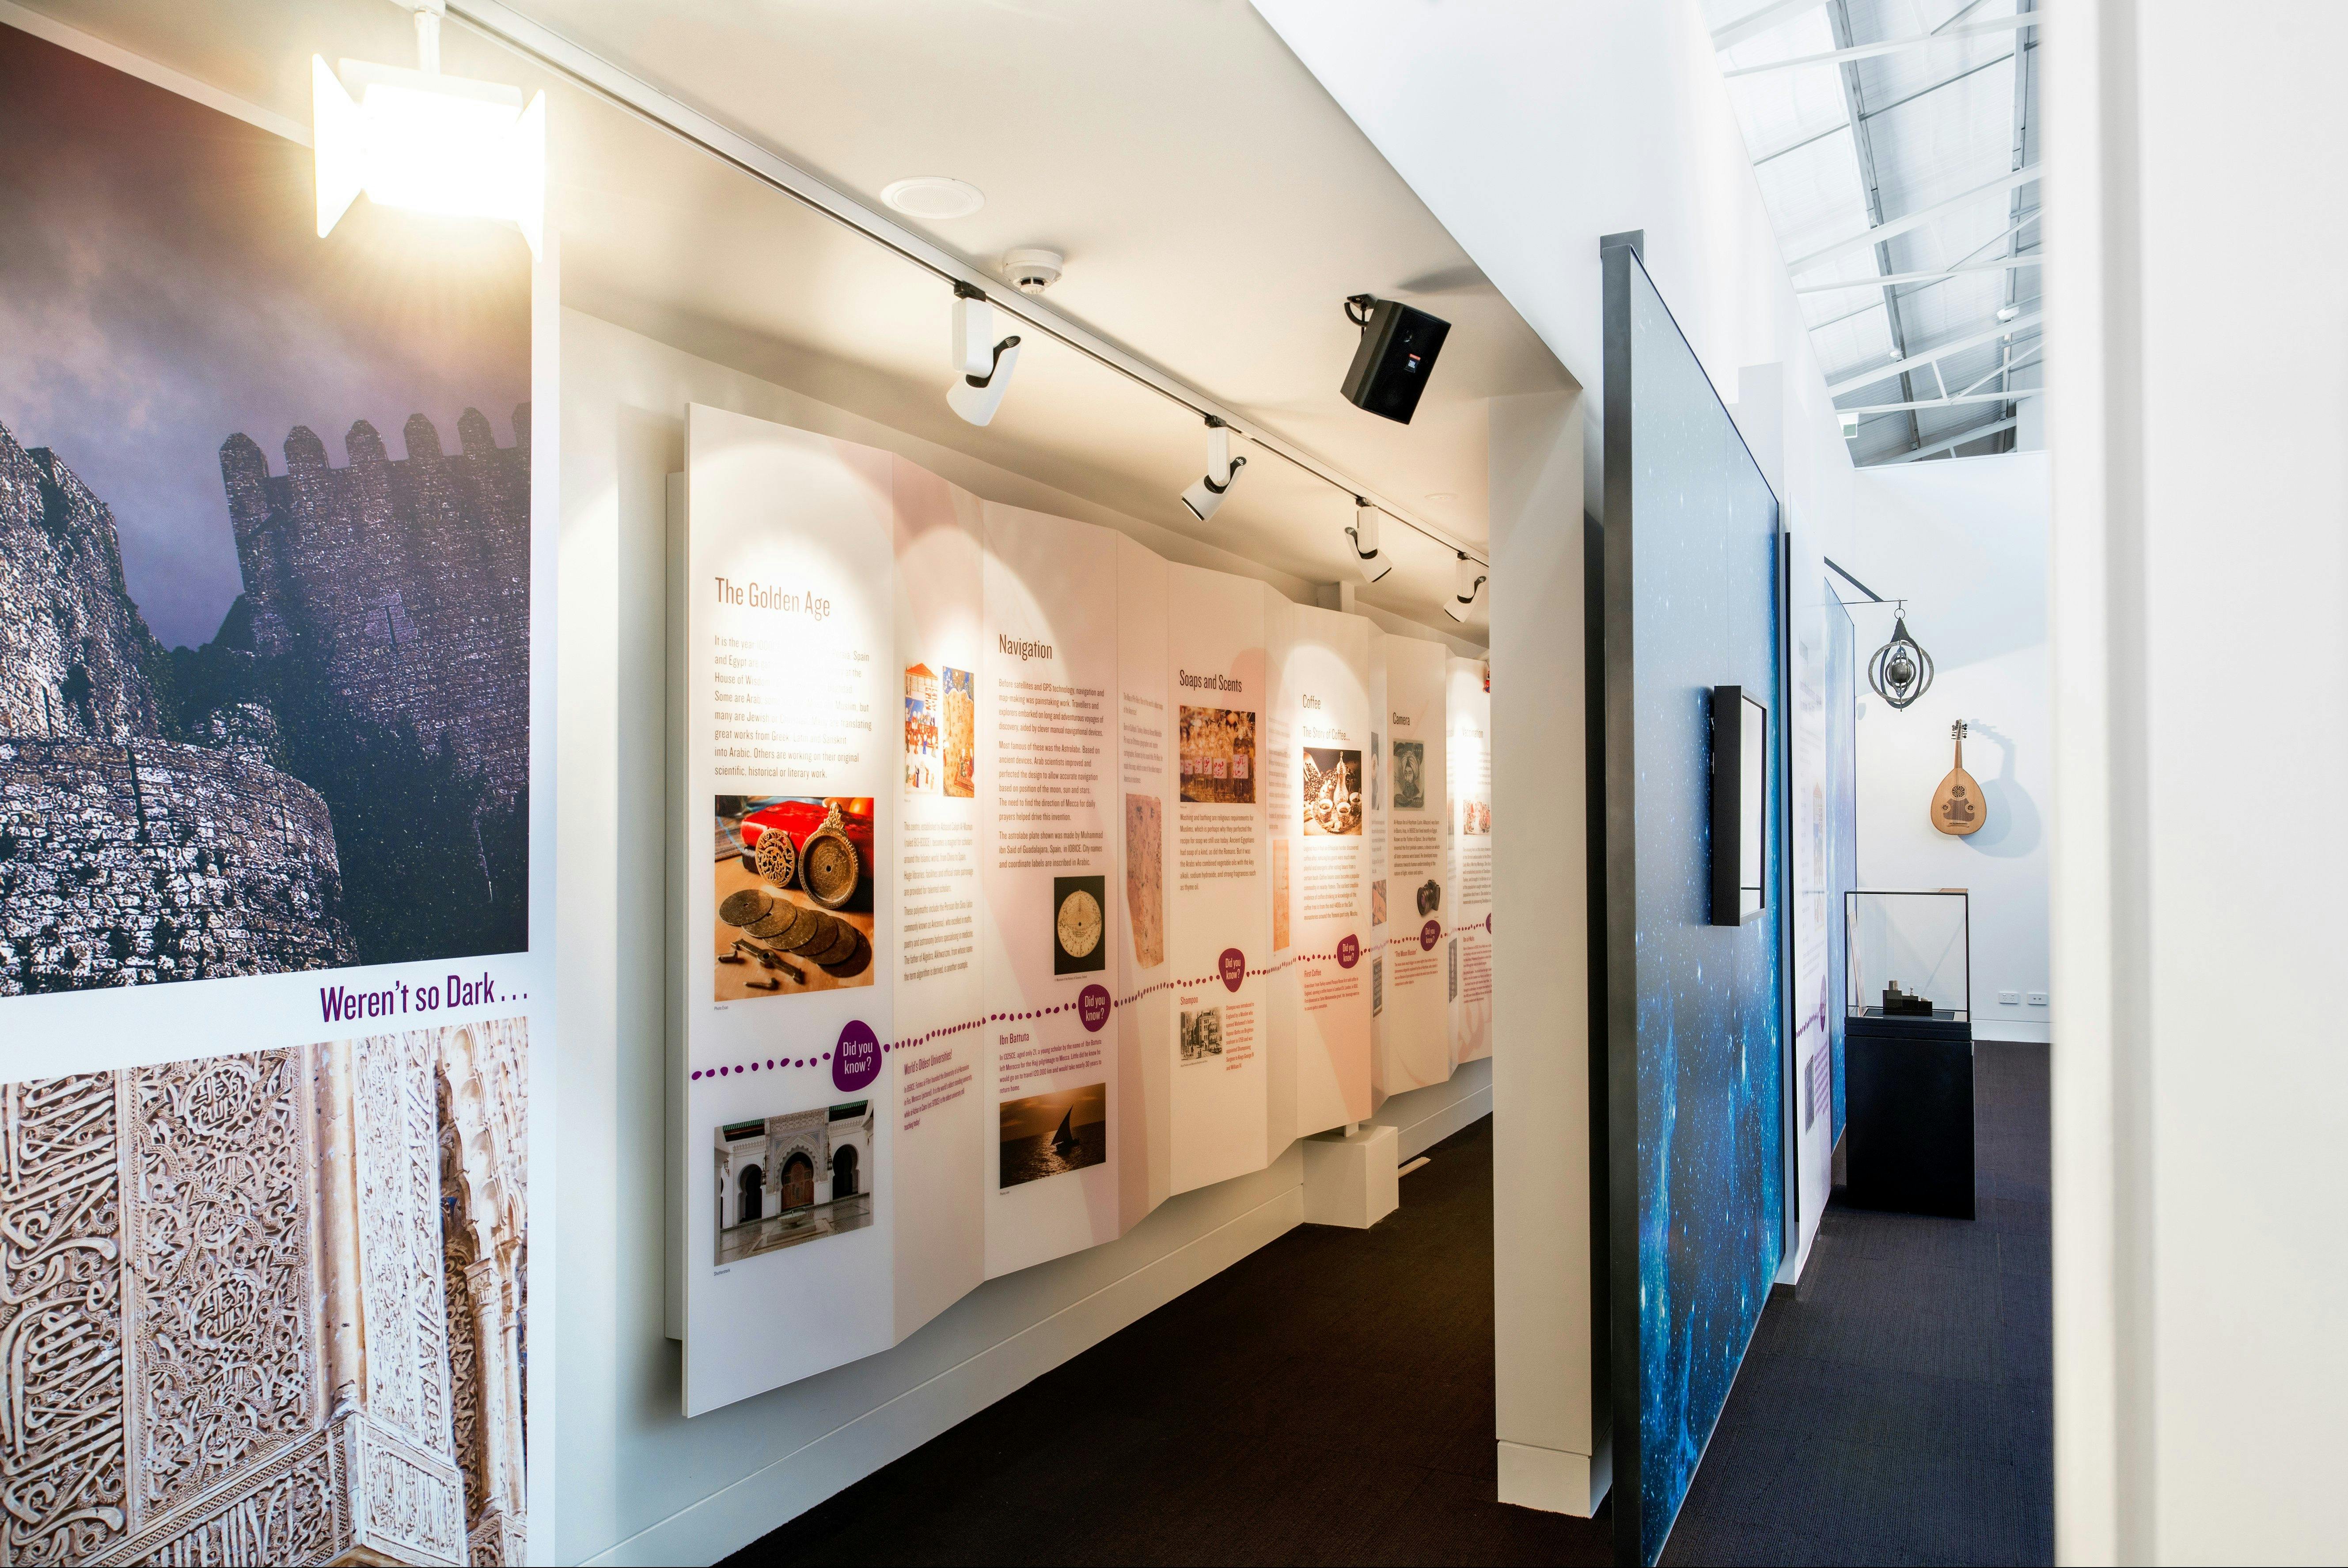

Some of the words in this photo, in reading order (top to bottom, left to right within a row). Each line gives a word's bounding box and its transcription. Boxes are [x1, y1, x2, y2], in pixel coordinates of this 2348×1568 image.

[715, 577, 743, 605] The
[748, 582, 799, 611] Golden
[805, 591, 830, 621] Age
[714, 634, 720, 646] It
[721, 636, 727, 647] is
[729, 637, 739, 648] the
[741, 641, 754, 650] year
[999, 634, 1052, 661] Navigation
[715, 655, 727, 664] and
[728, 656, 747, 668] Egypt
[853, 650, 869, 662] Spain
[715, 672, 735, 684] House
[737, 675, 743, 684] of
[1180, 669, 1202, 691] Soaps
[1204, 674, 1217, 689] and
[1218, 675, 1242, 692] Scents
[998, 678, 1013, 687] Before
[1014, 681, 1033, 690] satellites
[1043, 683, 1052, 691] GPS
[1052, 685, 1075, 695] technology,
[1076, 688, 1096, 697] navigation
[998, 695, 1025, 705] map-making
[1035, 698, 1059, 708] painstaking
[1072, 699, 1091, 709] Travellers
[1303, 694, 1320, 709] Coffee
[715, 712, 732, 722] many
[747, 711, 770, 723] Jewish
[1393, 712, 1410, 725] Camera
[841, 720, 872, 731] translating
[714, 730, 732, 740] great
[734, 730, 753, 740] works
[755, 730, 770, 740] from
[1303, 726, 1312, 737] The
[1313, 727, 1324, 740] Story
[1326, 729, 1331, 739] of
[714, 747, 727, 757] into
[729, 747, 752, 758] Arabic.
[754, 748, 775, 759] Others
[776, 752, 786, 760] are
[788, 752, 812, 763] working
[822, 752, 835, 762] their
[837, 753, 859, 764] original
[715, 765, 746, 776] scientific,
[748, 766, 778, 776] historical
[788, 767, 809, 780] literary
[811, 769, 827, 778] work.
[1199, 814, 1212, 822] bathing
[1028, 831, 1039, 841] plate
[1063, 831, 1074, 839] made
[1075, 831, 1080, 840] by
[1007, 845, 1017, 854] Said
[1022, 845, 1048, 854] Guadalajara,
[1343, 952, 1354, 962] know?
[1226, 969, 1240, 980] know?
[321, 980, 409, 1022] Weren't
[416, 986, 439, 1011] so
[1085, 995, 1094, 1007] Did
[1095, 997, 1105, 1008] you
[1180, 997, 1198, 1005] Shampoo
[1086, 1008, 1104, 1021] know?
[999, 1035, 1008, 1045] Ibn
[1009, 1033, 1029, 1044] Battuta
[843, 1040, 856, 1056] Did
[859, 1042, 872, 1057] you
[844, 1056, 871, 1074] know?
[919, 1058, 930, 1070] Oldest
[1039, 1058, 1055, 1066] pilgrimage
